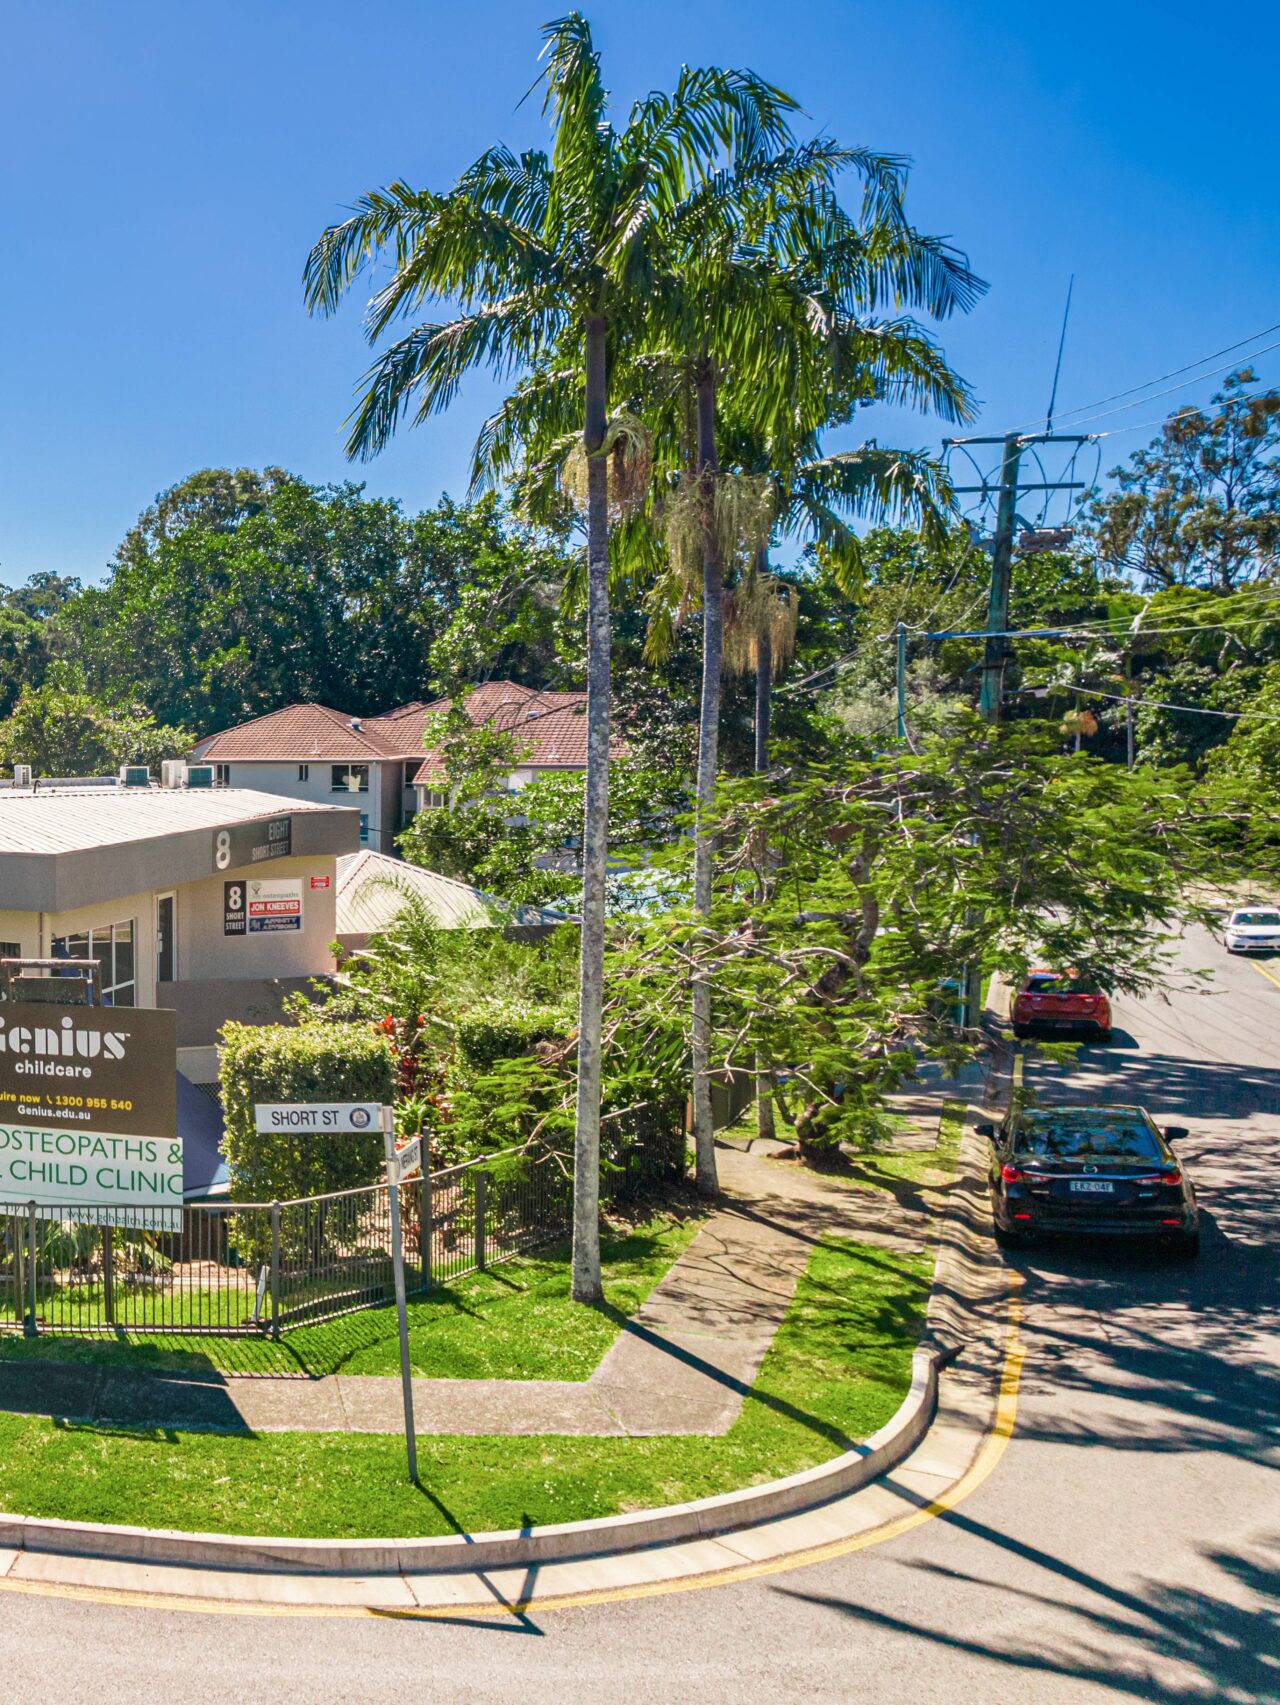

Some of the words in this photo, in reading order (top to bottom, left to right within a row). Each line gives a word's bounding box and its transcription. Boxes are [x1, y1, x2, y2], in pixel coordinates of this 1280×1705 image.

[268, 821, 289, 840] EIGHT
[216, 830, 231, 869] 8
[252, 844, 269, 861] SHORT
[270, 841, 289, 856] STREET
[229, 886, 242, 910] 8
[251, 903, 265, 912] JON
[267, 901, 299, 911] KNEEVES
[226, 912, 244, 920] SHORT
[225, 922, 245, 930] STREET
[15, 1060, 92, 1079] childcare
[17, 1104, 91, 1120] Genius.edu.au
[19, 1095, 41, 1103] now
[55, 1096, 83, 1106] 1300
[86, 1098, 108, 1108] 955
[110, 1099, 133, 1110] 540
[271, 1110, 318, 1126] SHORT
[322, 1110, 339, 1125] ST
[167, 1143, 183, 1165] &
[9, 1159, 87, 1187] CHILD
[96, 1168, 183, 1196] CLINIC
